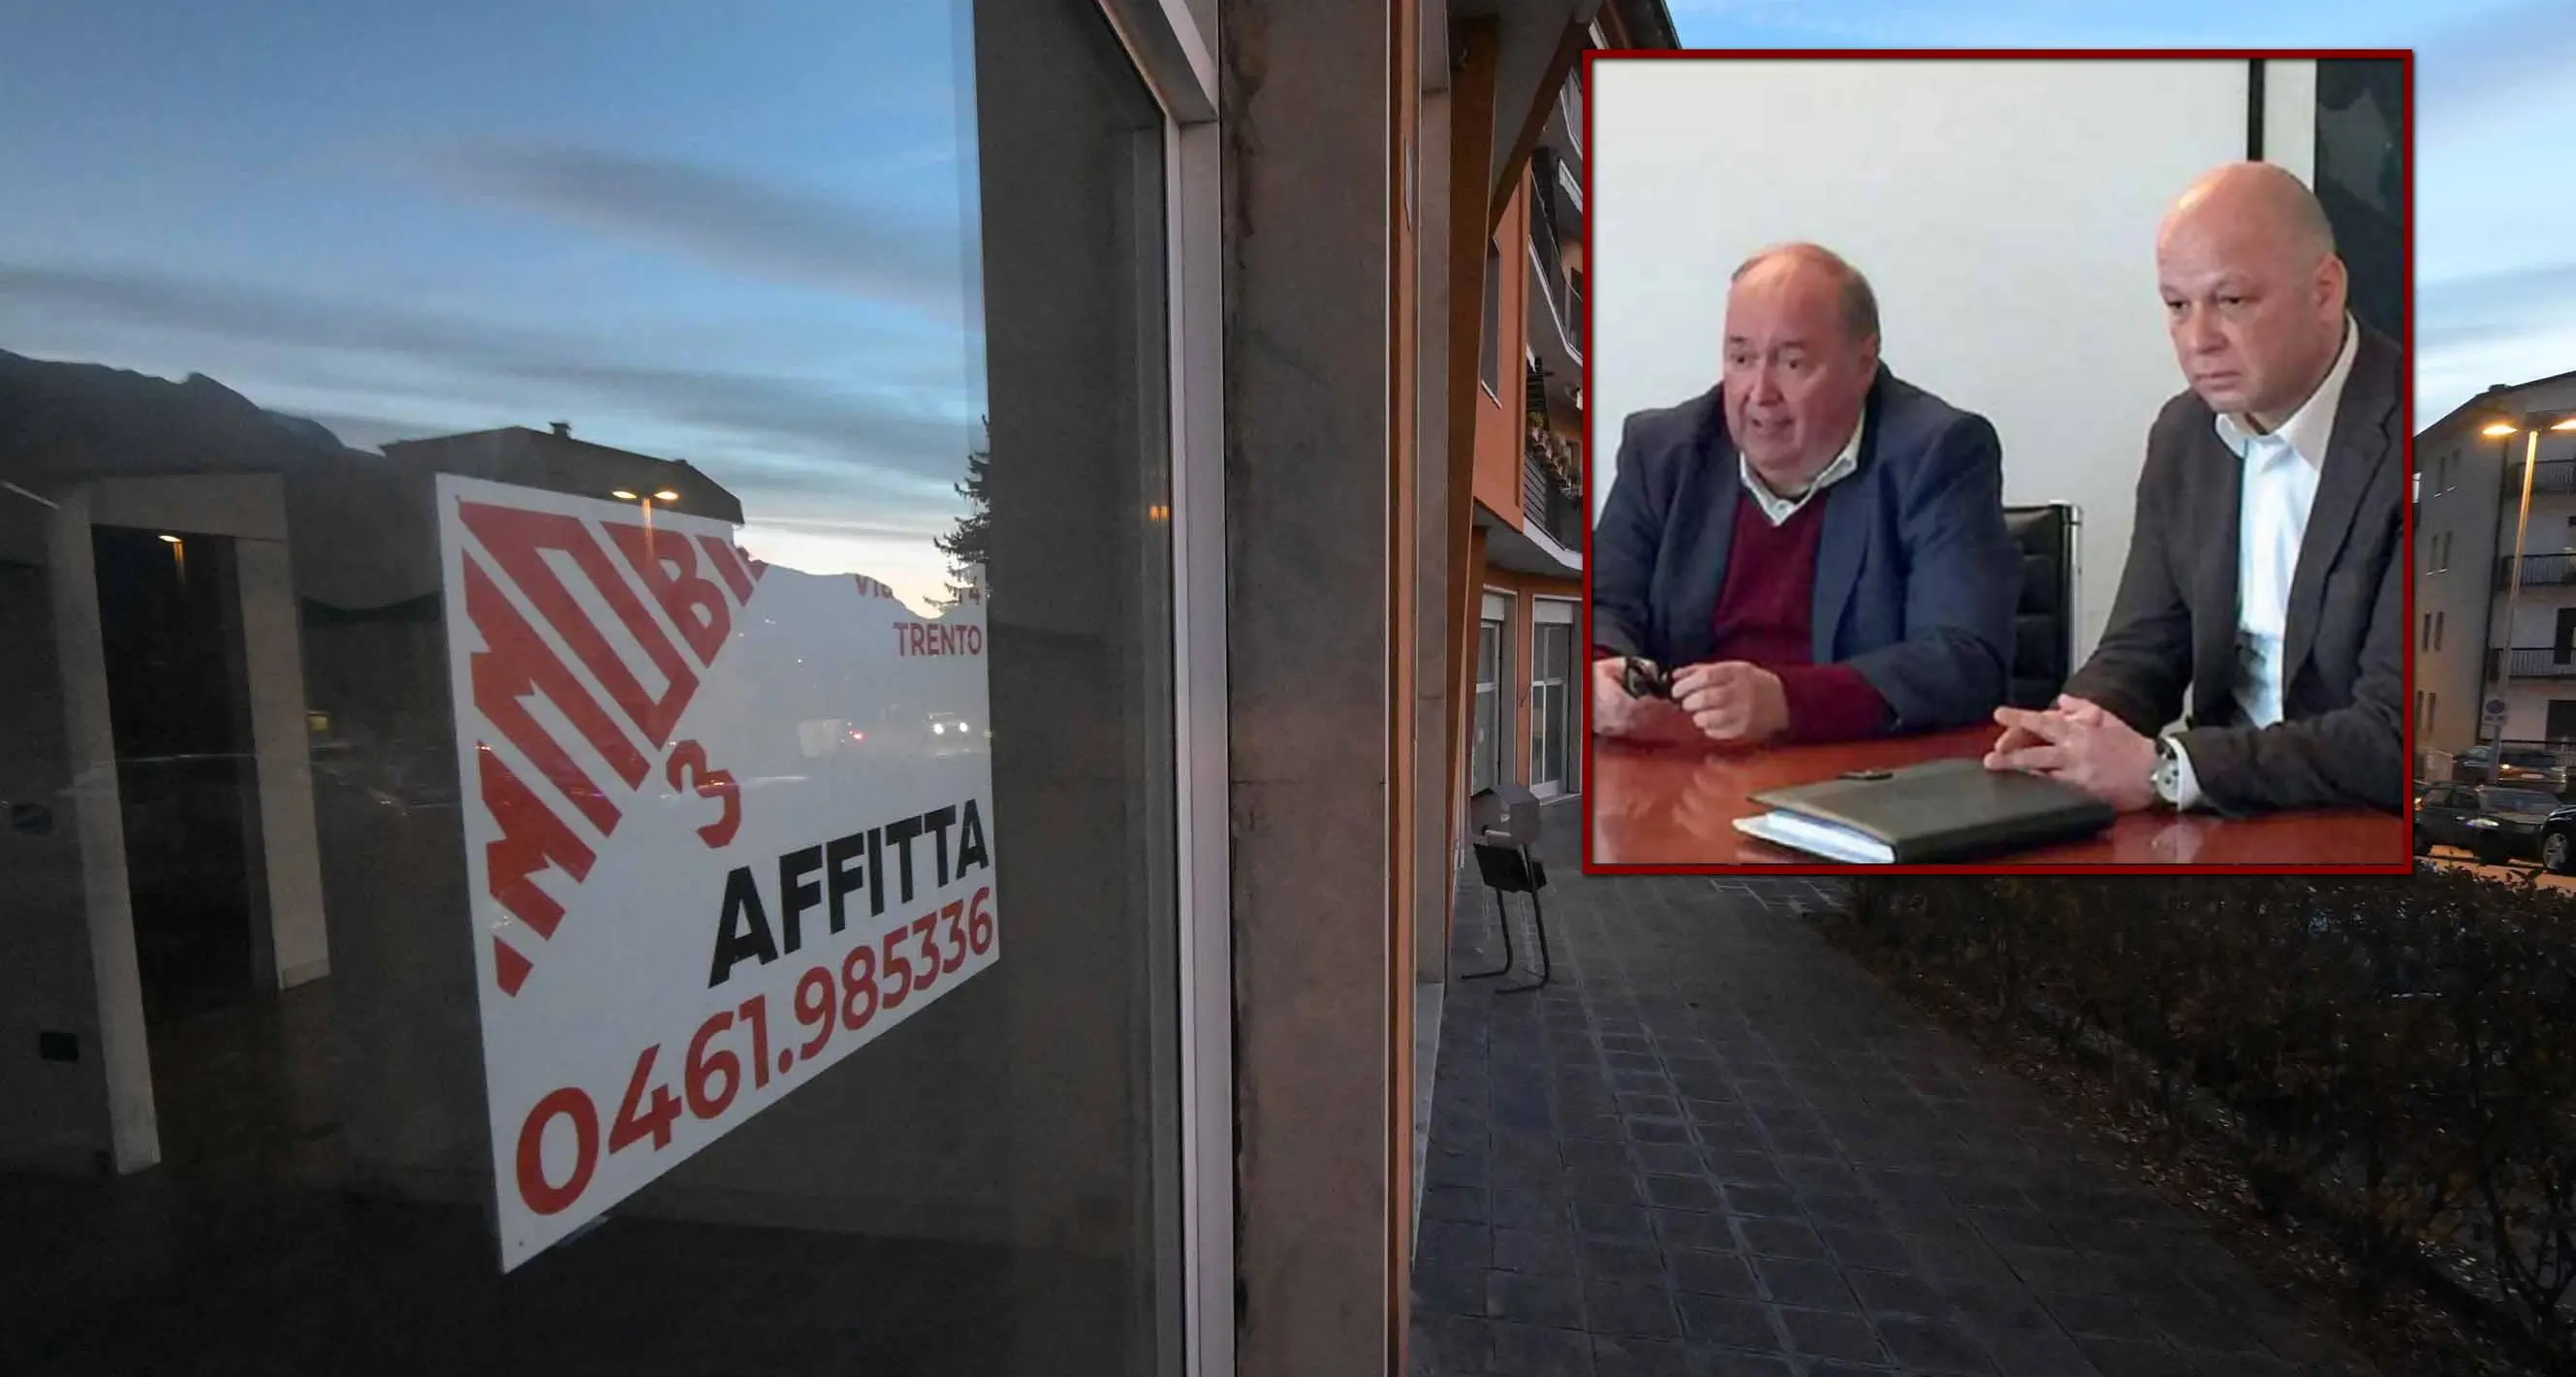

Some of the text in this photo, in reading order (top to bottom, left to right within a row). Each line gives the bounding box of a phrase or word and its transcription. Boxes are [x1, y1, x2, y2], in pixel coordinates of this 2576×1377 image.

[893, 621, 983, 657] TRENTO
[666, 739, 741, 849] 3
[708, 799, 990, 988] AFFITTA
[516, 887, 993, 1215] 0461.985336
